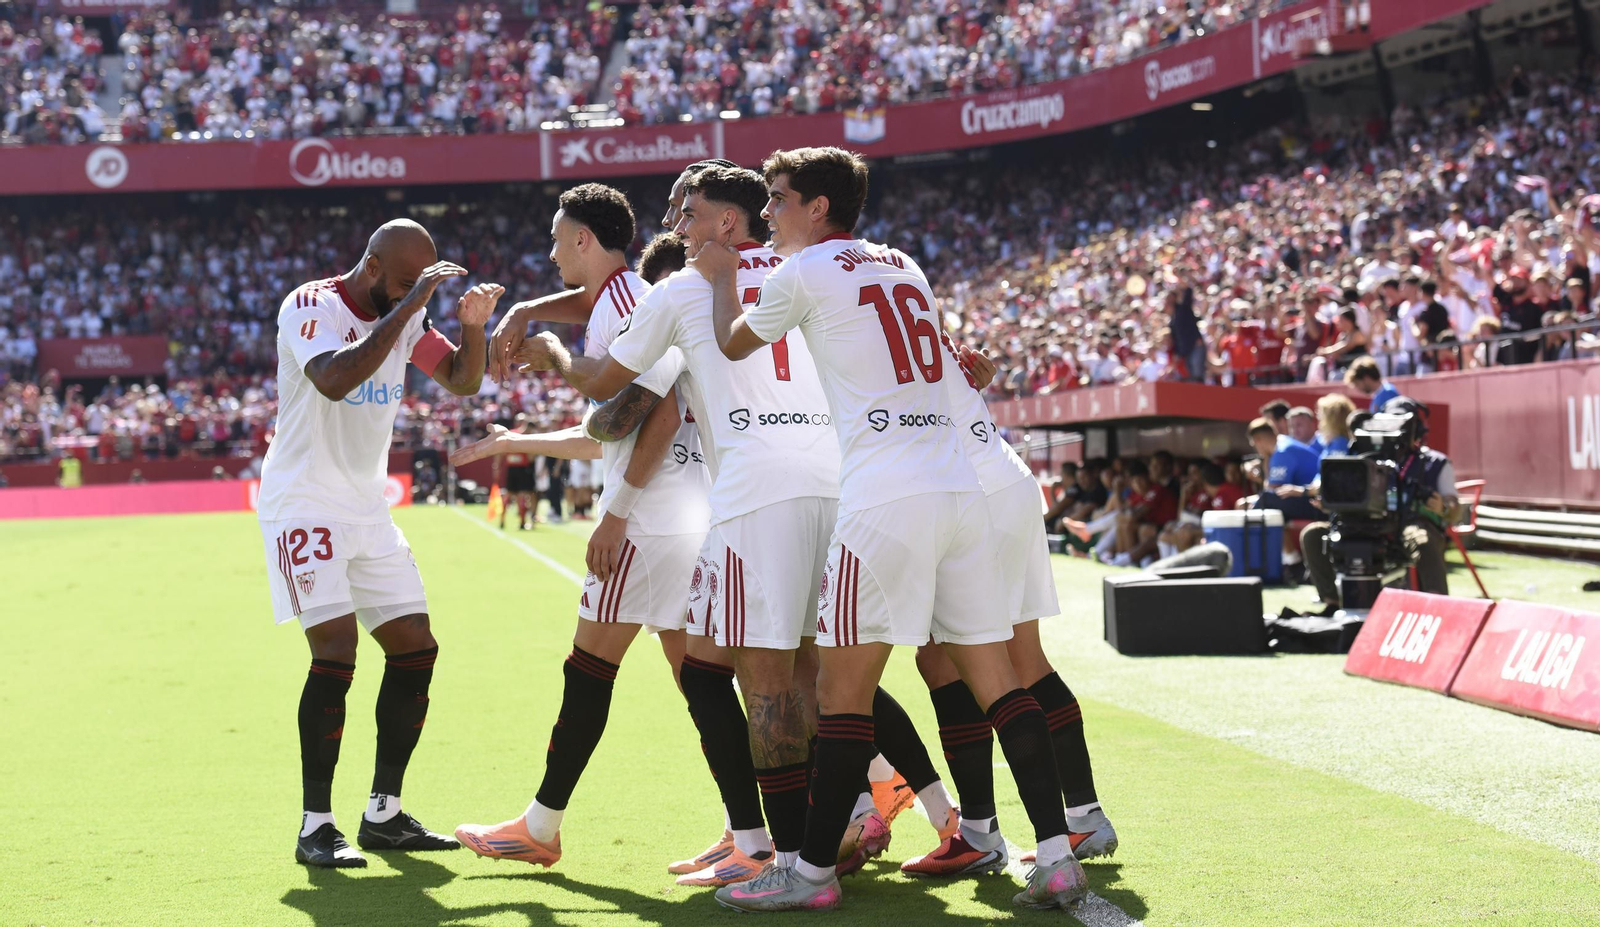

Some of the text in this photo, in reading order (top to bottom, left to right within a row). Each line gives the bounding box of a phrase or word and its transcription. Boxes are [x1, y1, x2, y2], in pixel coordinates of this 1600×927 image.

[961, 93, 1065, 135] Cruzcampo
[291, 139, 406, 184] Midea
[593, 134, 708, 164] CaixaBank
[858, 284, 943, 384] 16
[758, 412, 832, 426] SOCIOS.CO
[289, 527, 333, 566] 23
[1379, 611, 1442, 664] LALIGA
[1501, 629, 1586, 690] LALIGA
